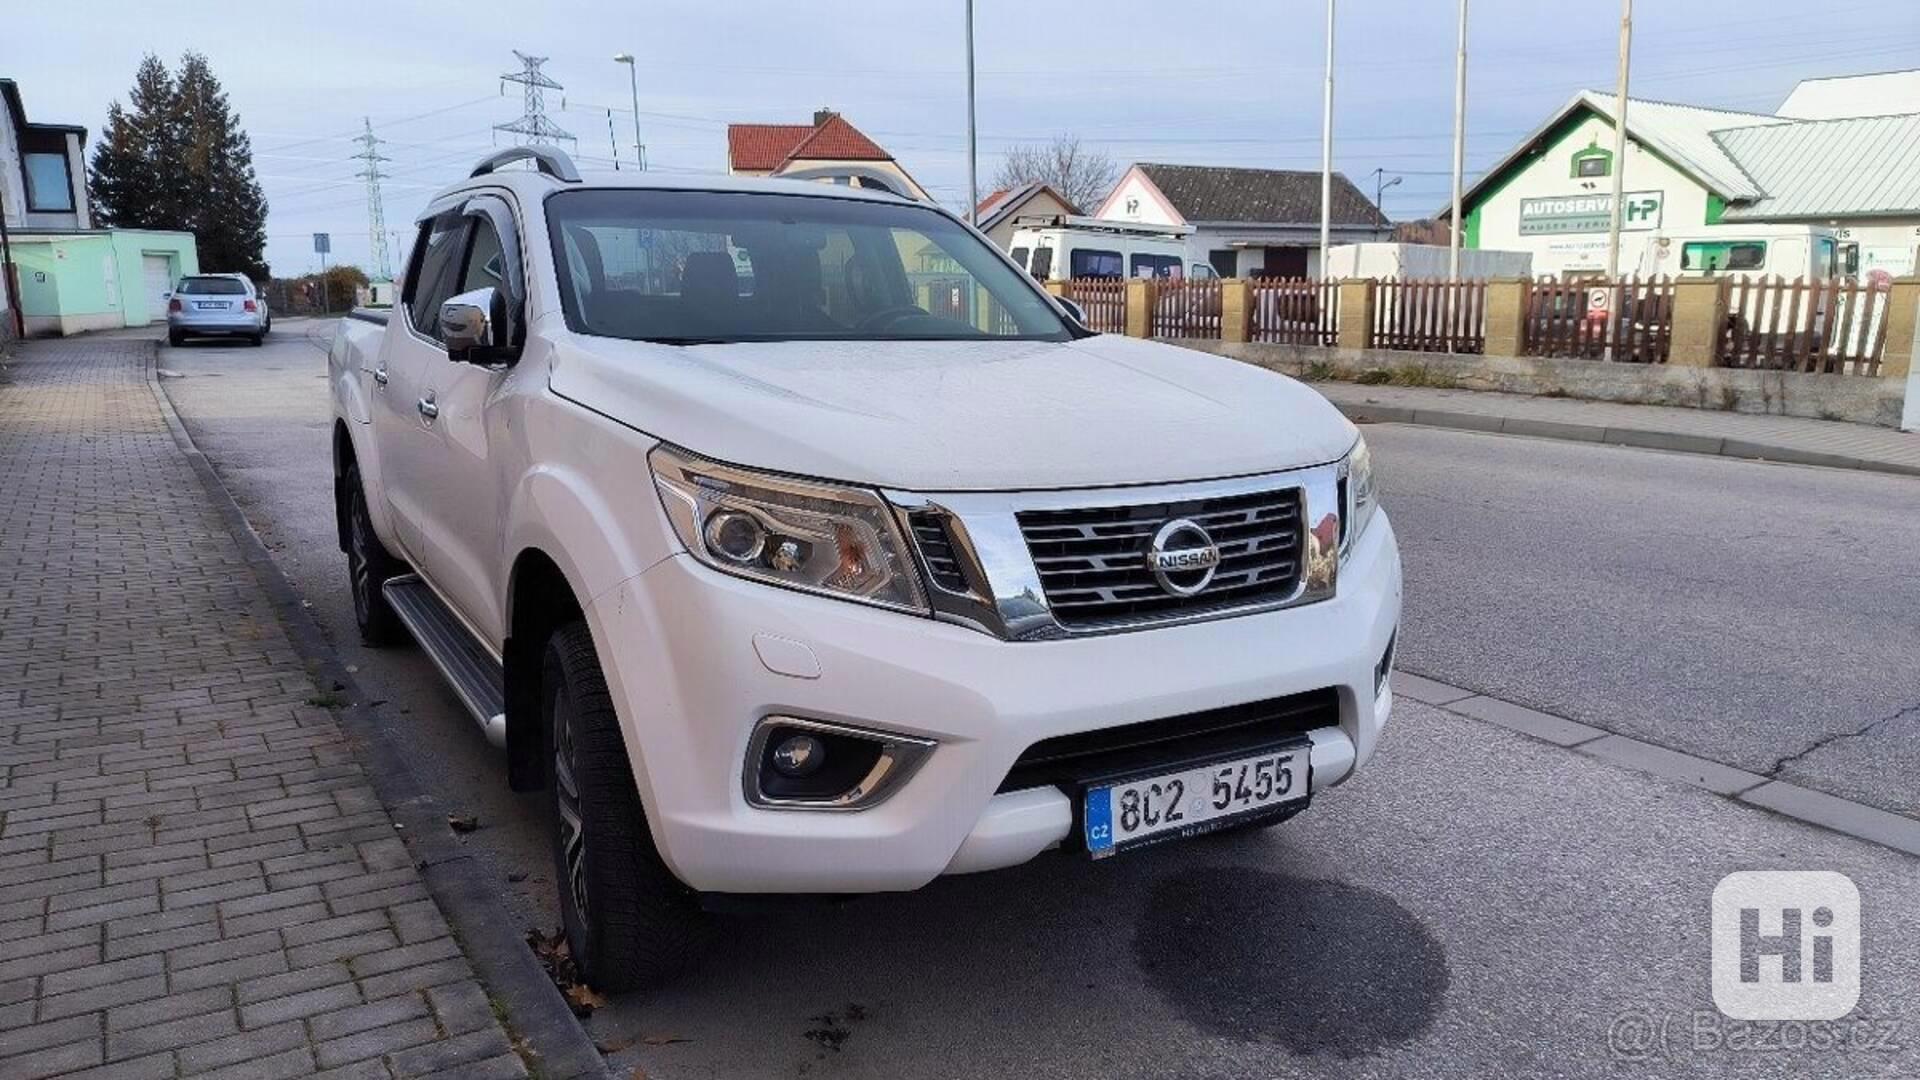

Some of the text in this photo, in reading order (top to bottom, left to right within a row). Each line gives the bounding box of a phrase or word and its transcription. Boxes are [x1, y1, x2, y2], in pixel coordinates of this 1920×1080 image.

[1522, 198, 1624, 216] AUTOSERVI
[1159, 549, 1217, 567] NISSAN
[1119, 779, 1184, 832] 8C2
[1212, 754, 1294, 810] 5455
[1090, 825, 1108, 840] CZ
